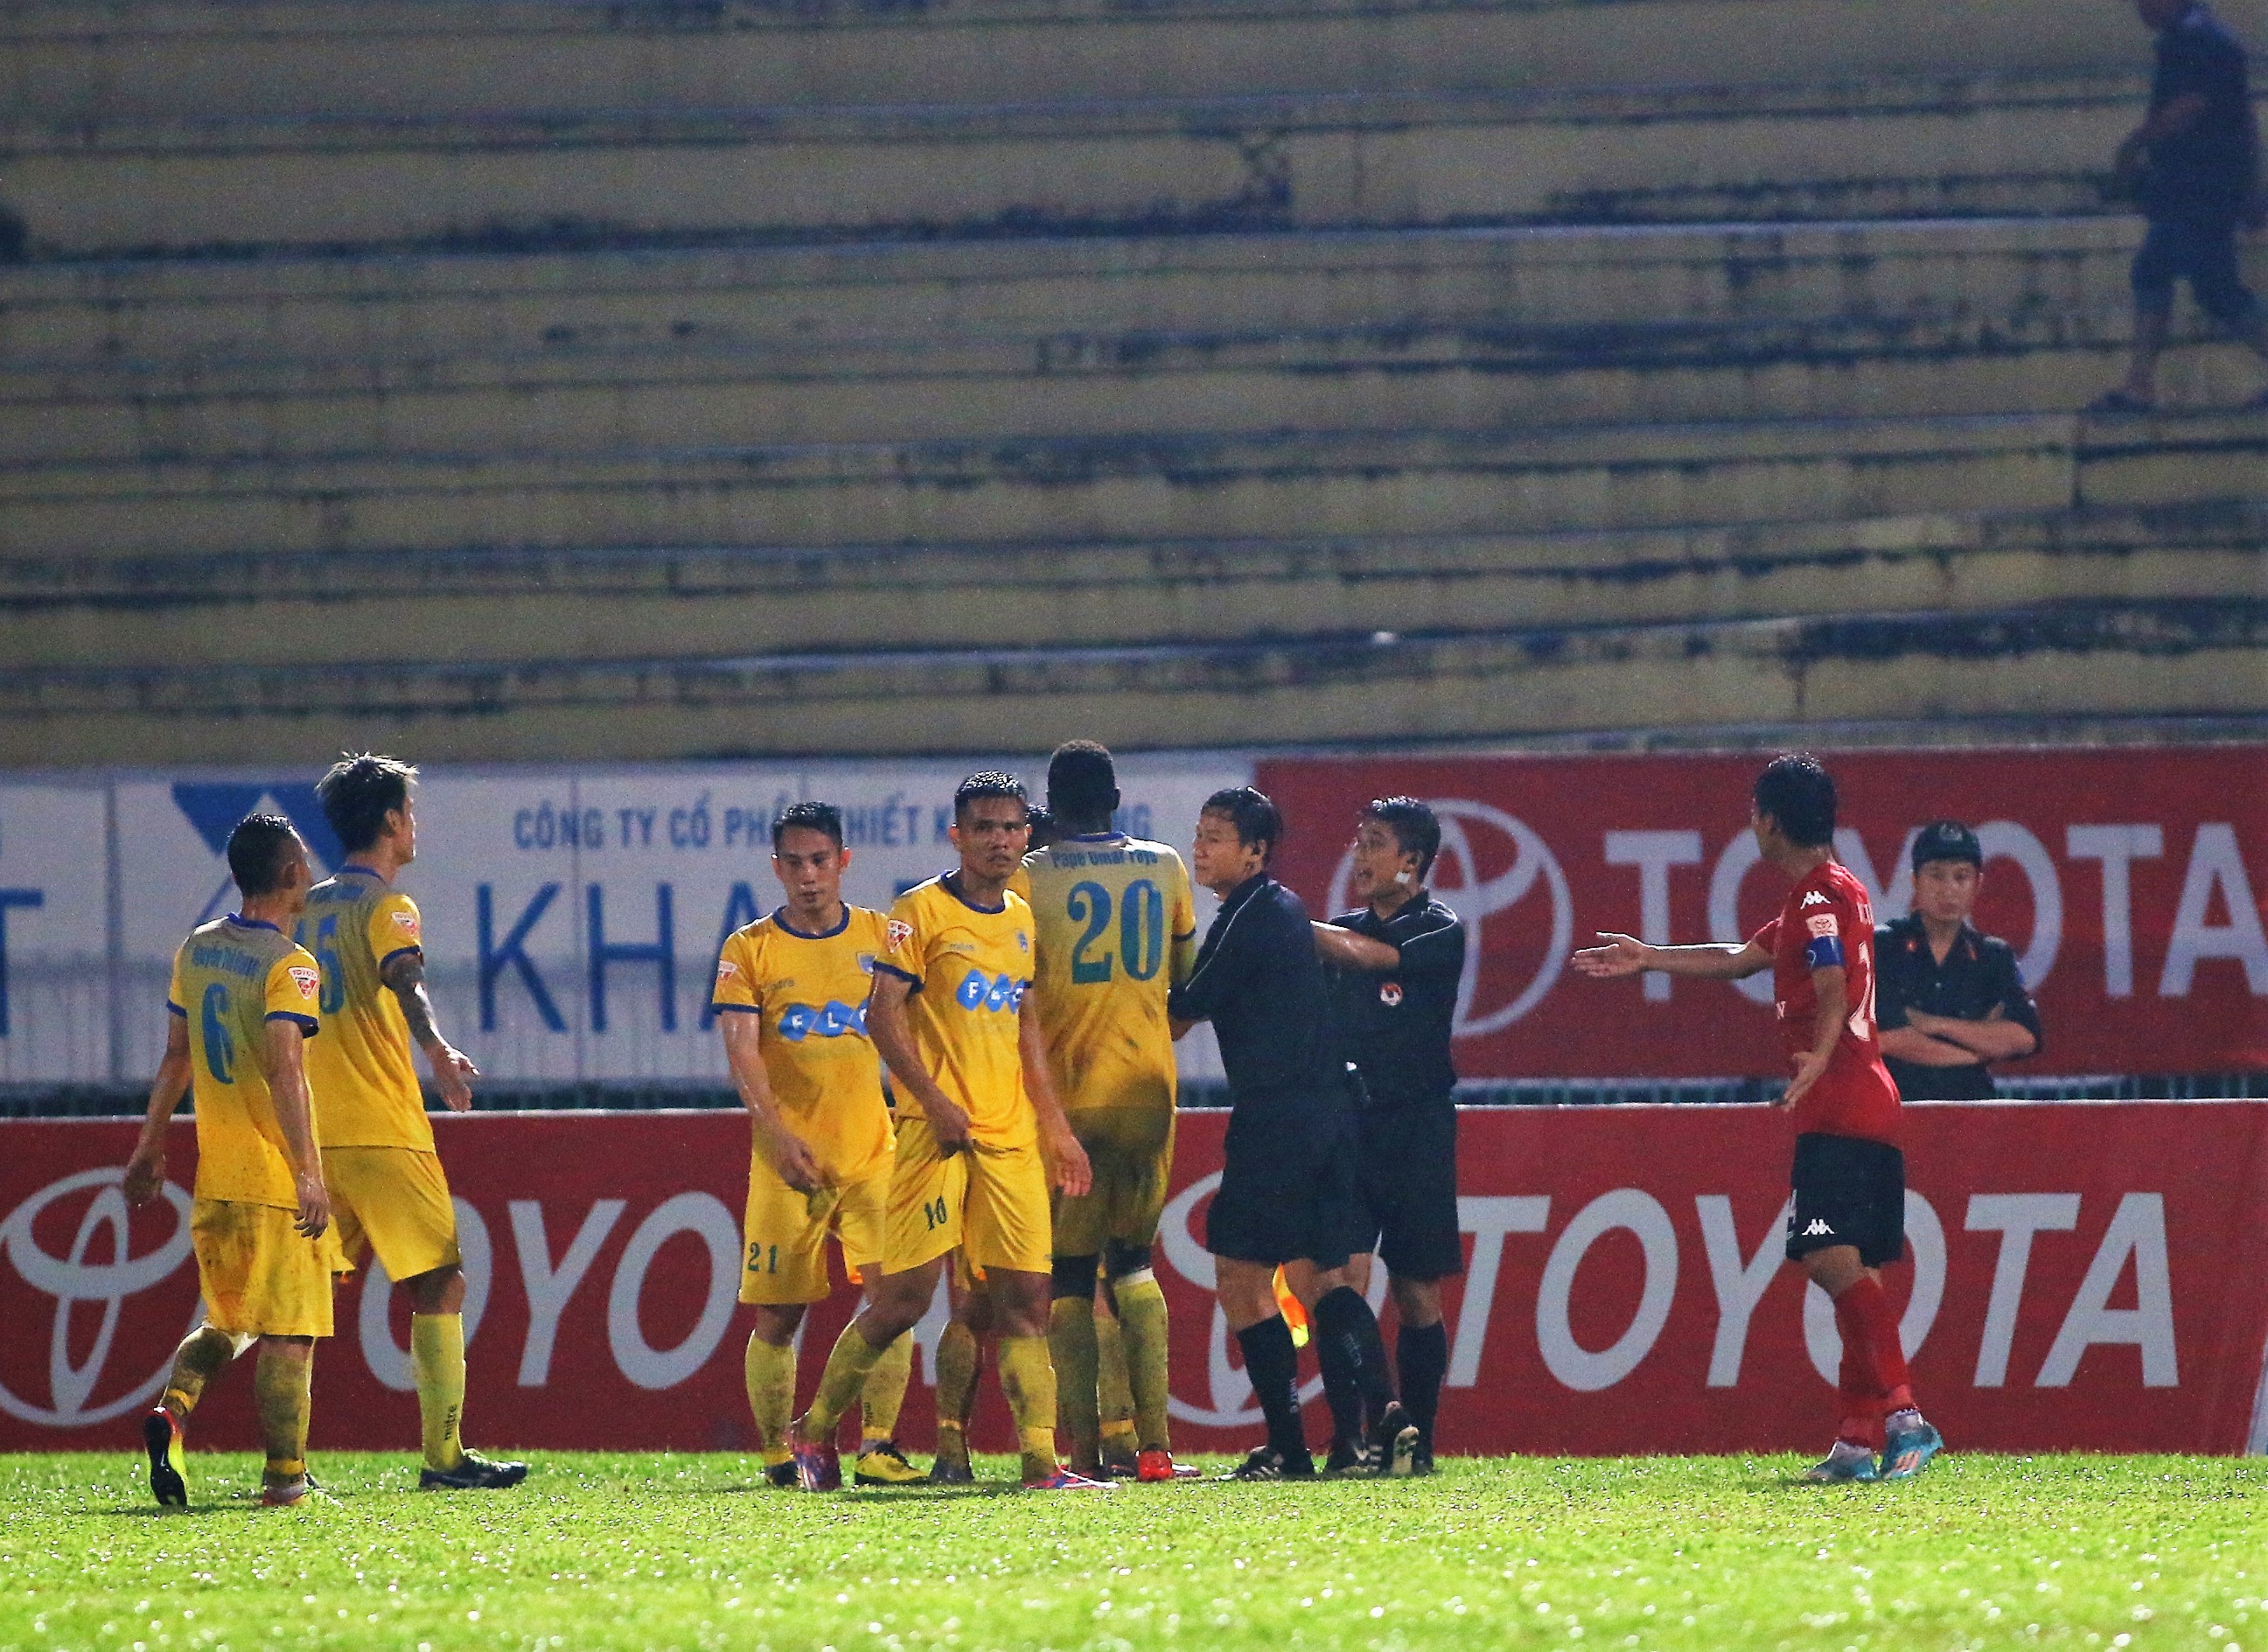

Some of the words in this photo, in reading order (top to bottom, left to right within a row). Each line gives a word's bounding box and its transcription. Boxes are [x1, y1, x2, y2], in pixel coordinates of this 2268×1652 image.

[513, 798, 604, 849] CÔNG
[618, 807, 655, 847] TY
[846, 790, 923, 846] HIẾT
[1066, 879, 1163, 985] 20
[201, 983, 234, 1085] 6
[925, 1195, 947, 1230] 10
[748, 1242, 778, 1273] 21
[1445, 1188, 2180, 1392] TOYOTA
